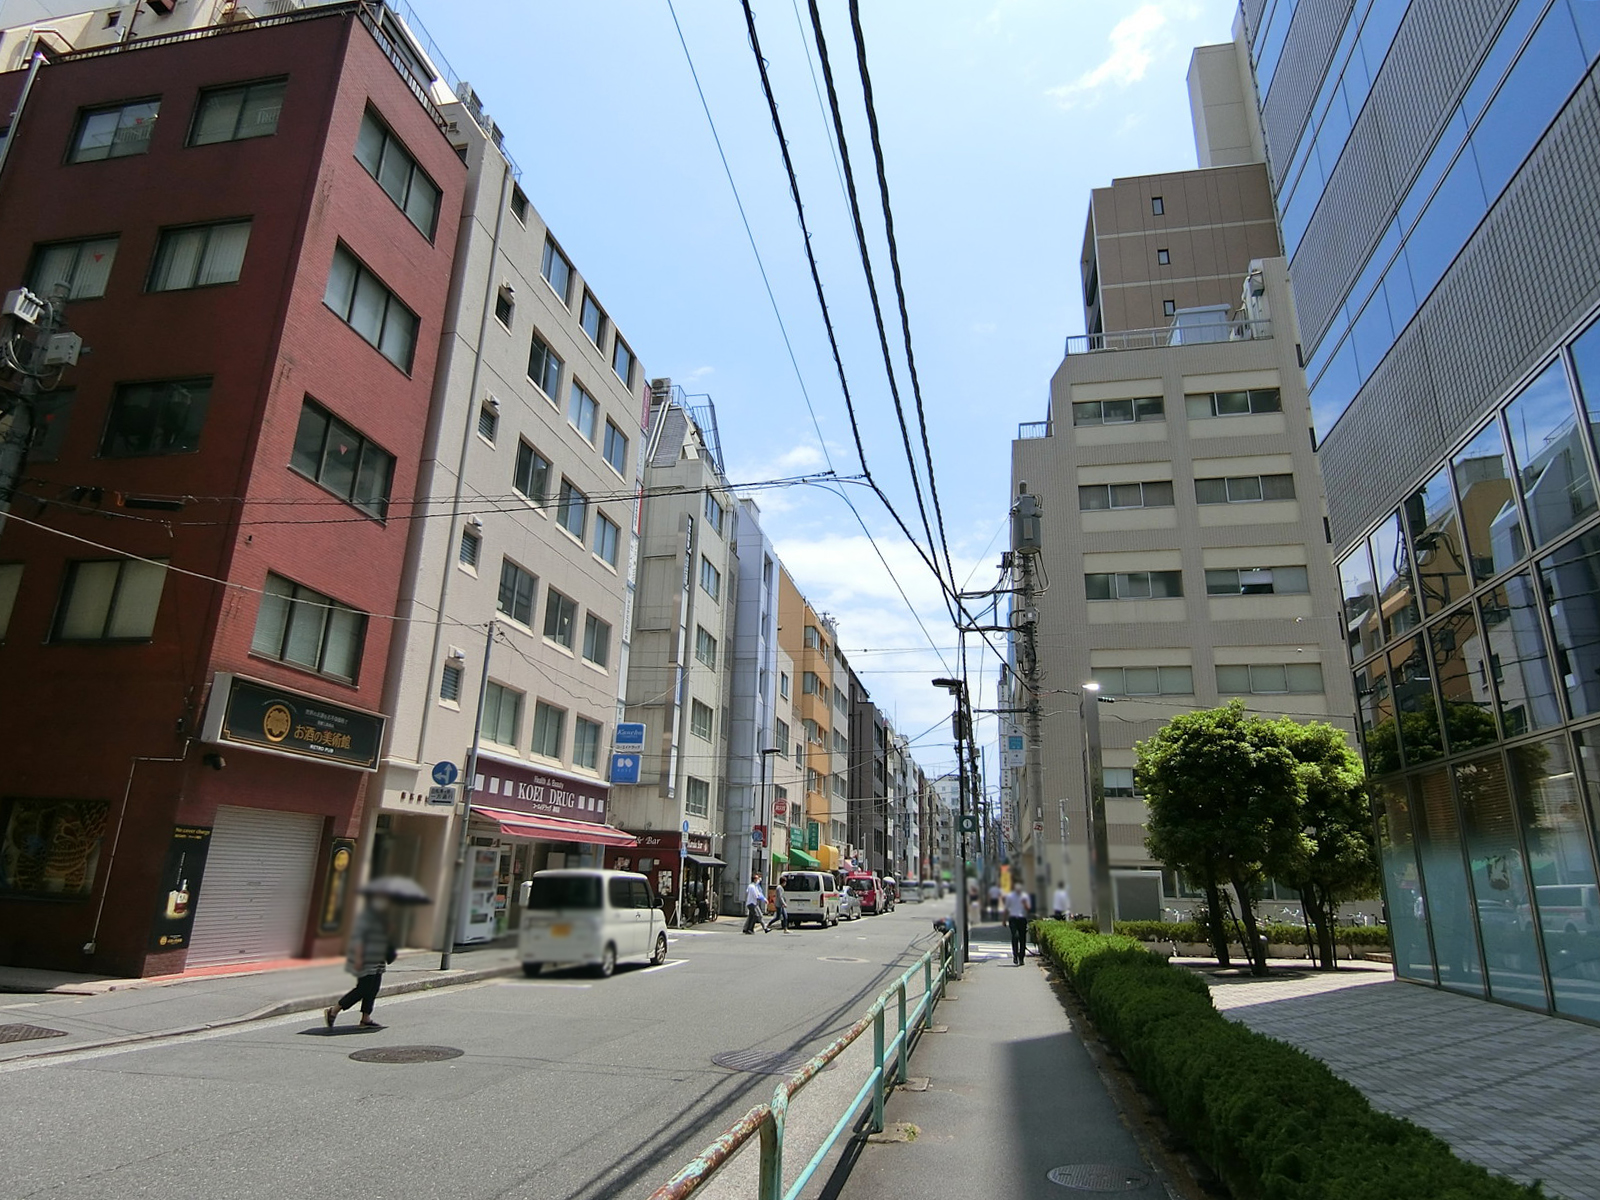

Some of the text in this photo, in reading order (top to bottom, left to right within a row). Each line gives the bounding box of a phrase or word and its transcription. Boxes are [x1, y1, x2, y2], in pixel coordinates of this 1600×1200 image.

[295, 725, 351, 749] お酒の美術館
[517, 782, 575, 808] KOEI DRUG
[645, 836, 661, 845] Bar
